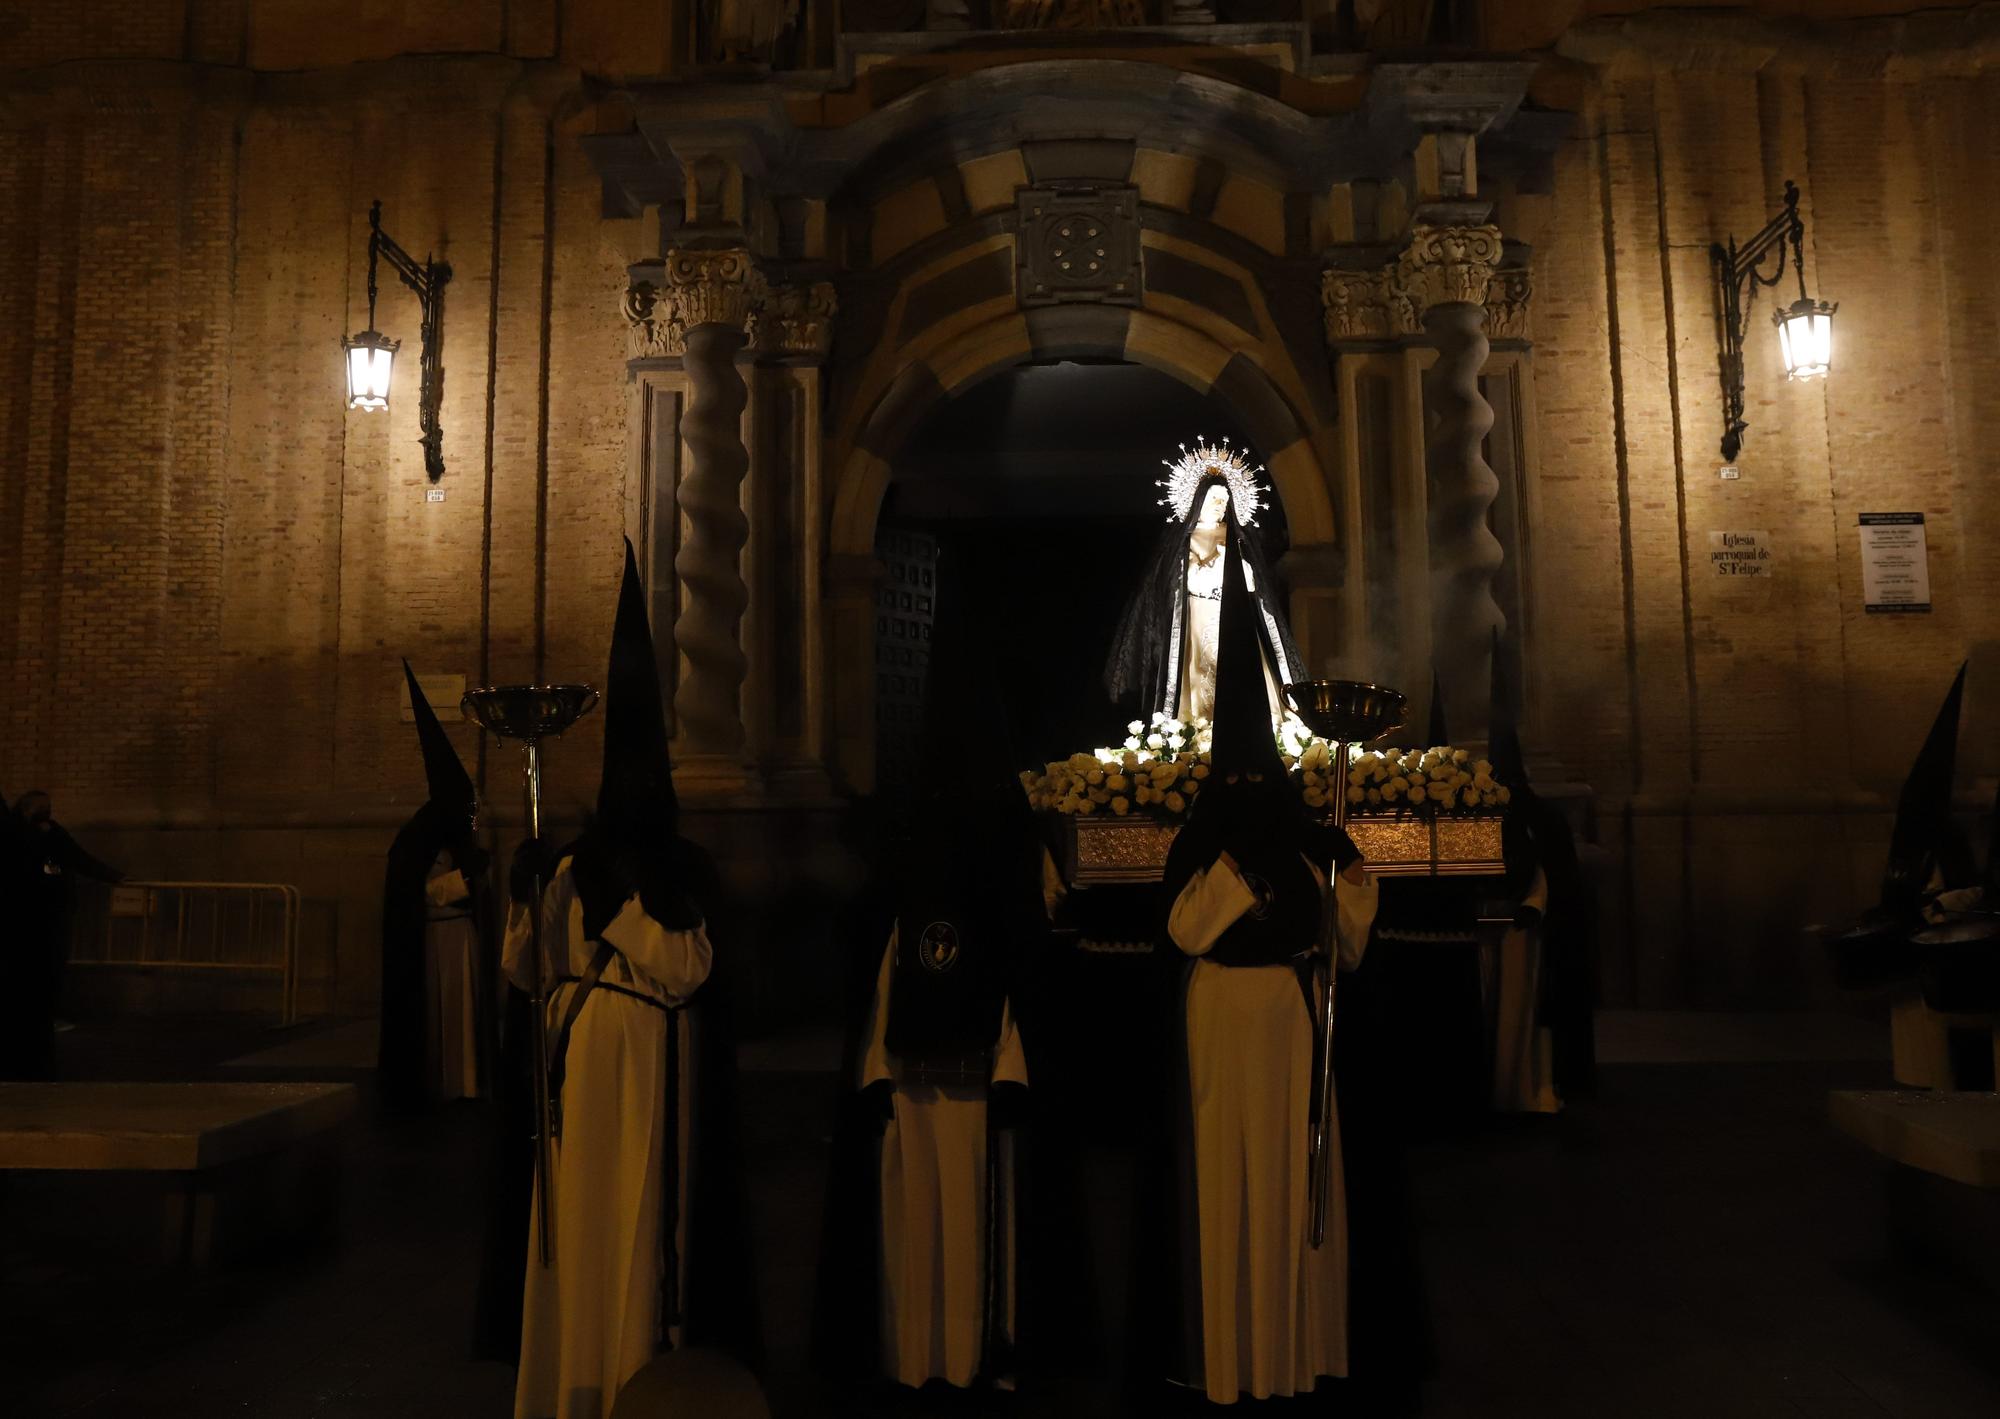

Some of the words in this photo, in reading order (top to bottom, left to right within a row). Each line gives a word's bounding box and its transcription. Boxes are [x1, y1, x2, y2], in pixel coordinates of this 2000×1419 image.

[1723, 533, 1755, 548] Iglesia
[1758, 547, 1769, 560] de
[1732, 562, 1762, 577] Felipe
